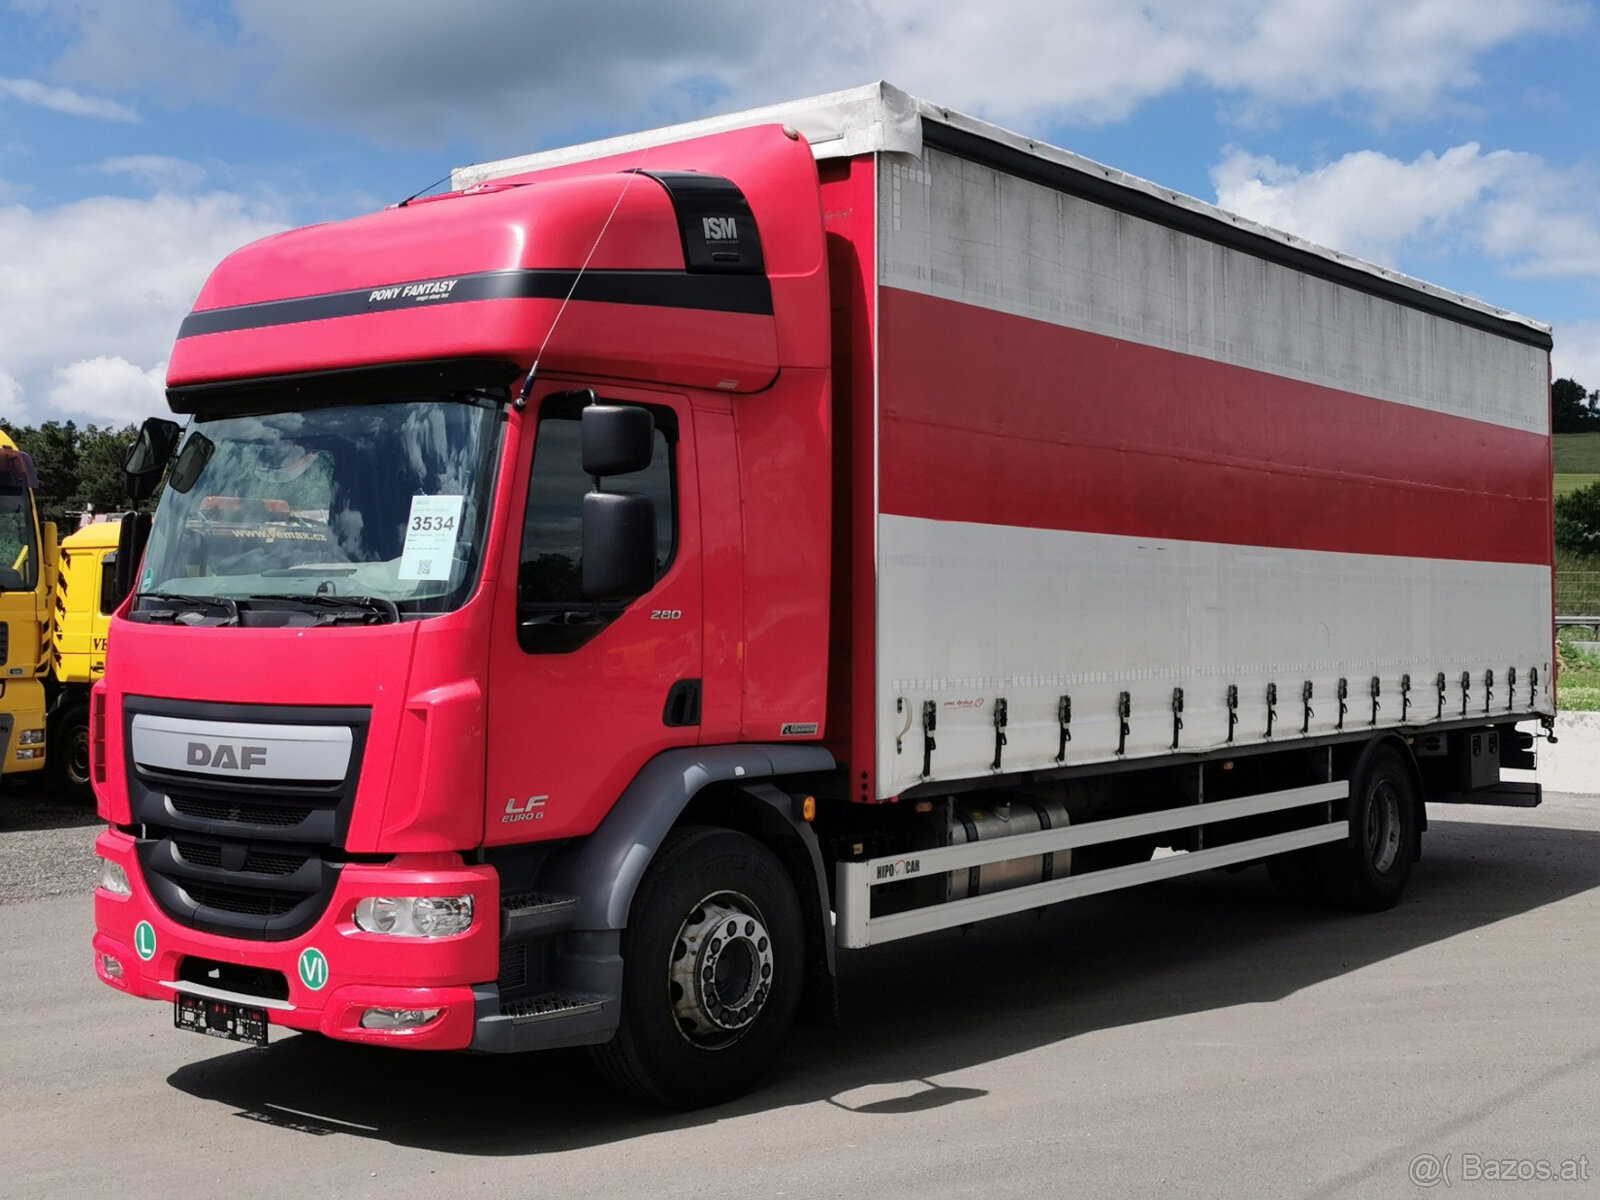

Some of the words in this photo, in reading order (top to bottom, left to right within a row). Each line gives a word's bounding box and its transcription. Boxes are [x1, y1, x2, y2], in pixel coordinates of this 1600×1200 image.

[703, 217, 738, 240] ISM
[369, 287, 402, 302] PONY
[402, 280, 458, 298] FANTASY
[411, 516, 455, 531] 3534
[650, 610, 682, 620] 280
[187, 742, 267, 770] DAF
[505, 795, 549, 814] LF
[501, 813, 534, 823] EURO
[535, 811, 545, 819] 6
[876, 863, 895, 880] HIPO
[905, 860, 920, 874] CAR
[139, 926, 152, 954] L
[302, 954, 323, 984] VI
